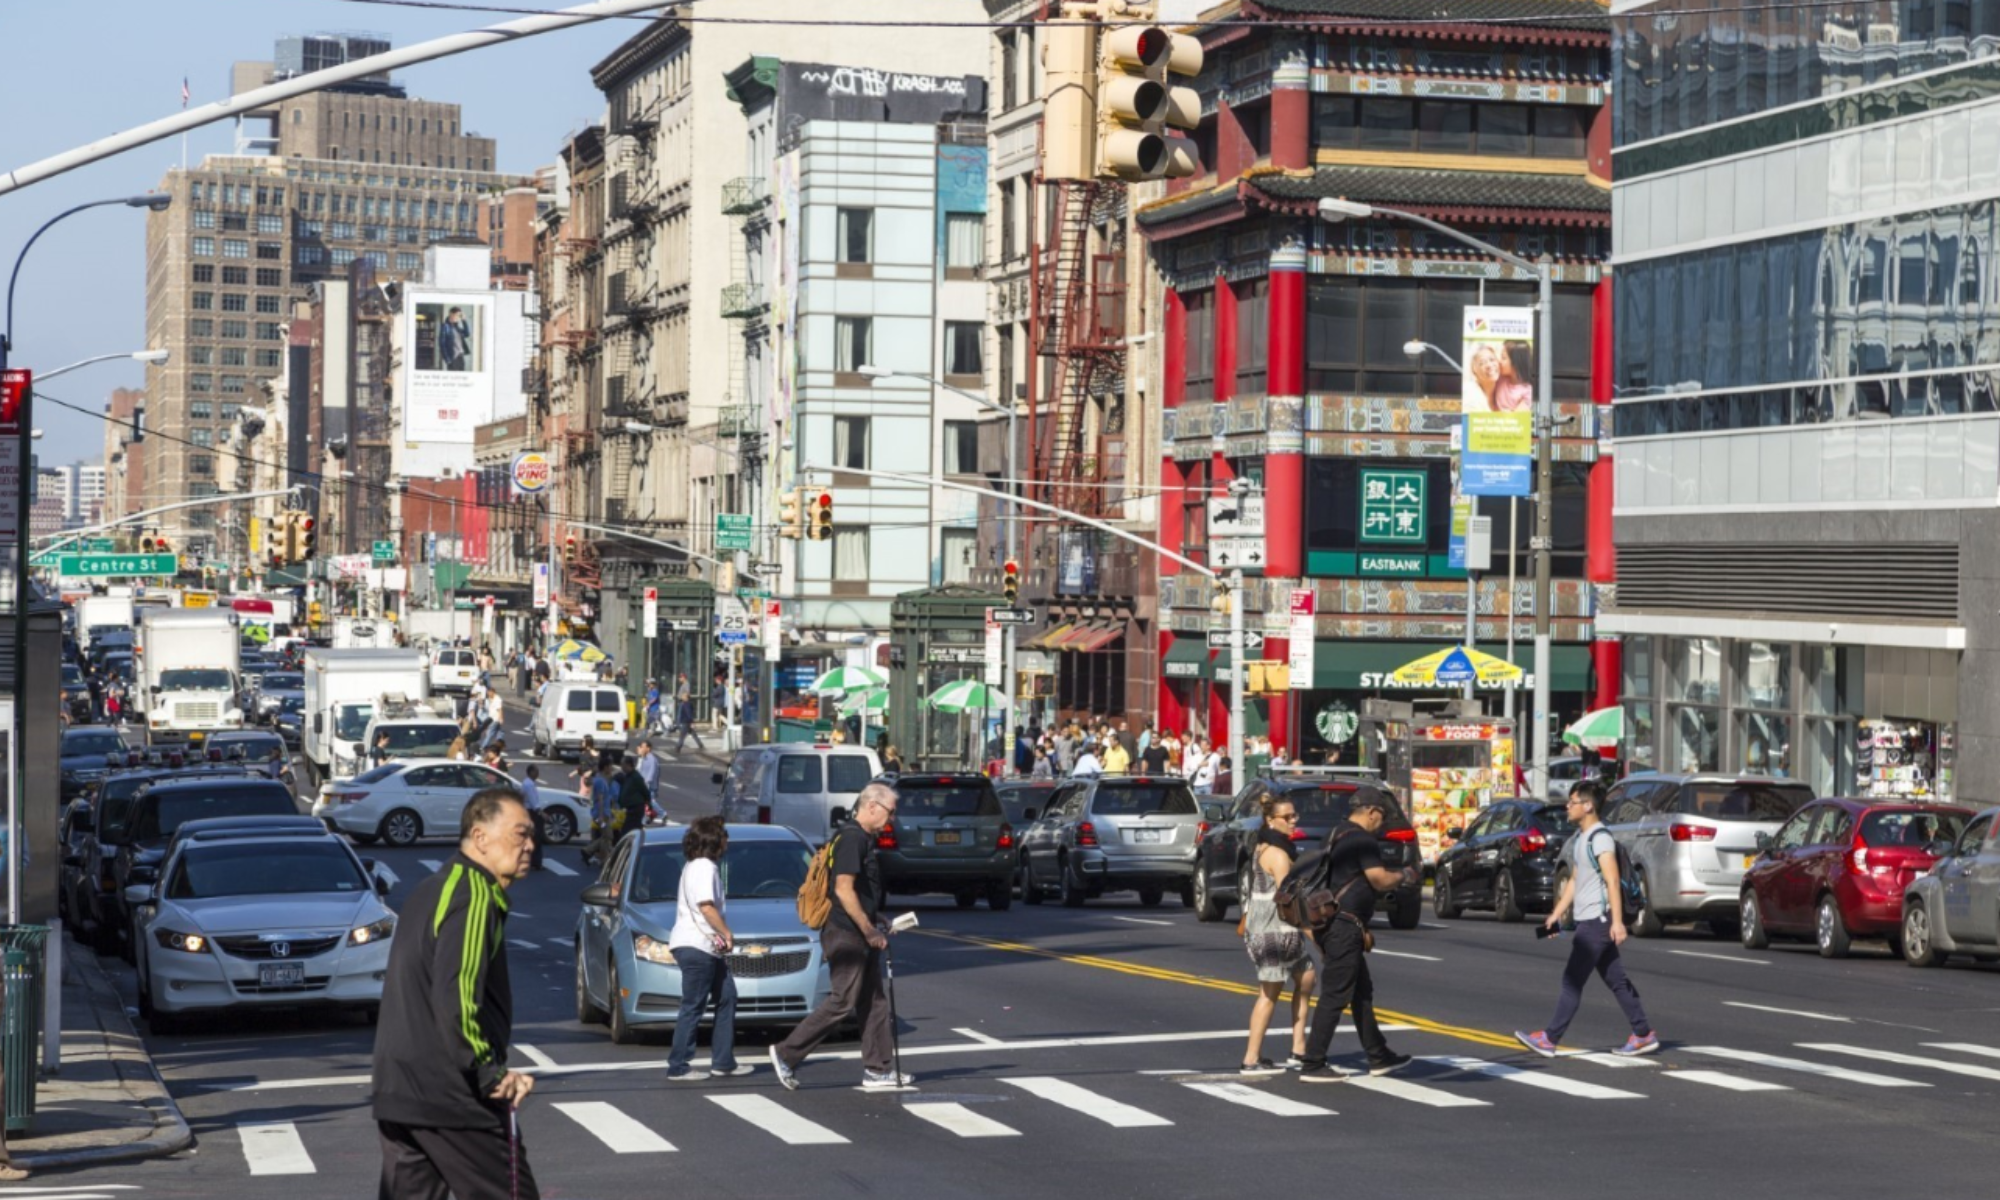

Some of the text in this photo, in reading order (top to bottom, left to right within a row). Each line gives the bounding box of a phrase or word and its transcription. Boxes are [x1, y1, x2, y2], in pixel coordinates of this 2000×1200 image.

[517, 470, 548, 480] KING
[1239, 541, 1261, 549] LOCAL
[79, 558, 158, 572] Centre St
[1362, 558, 1421, 571] EASTBANK
[724, 616, 744, 629] 25
[1445, 730, 1481, 740] FOOD
